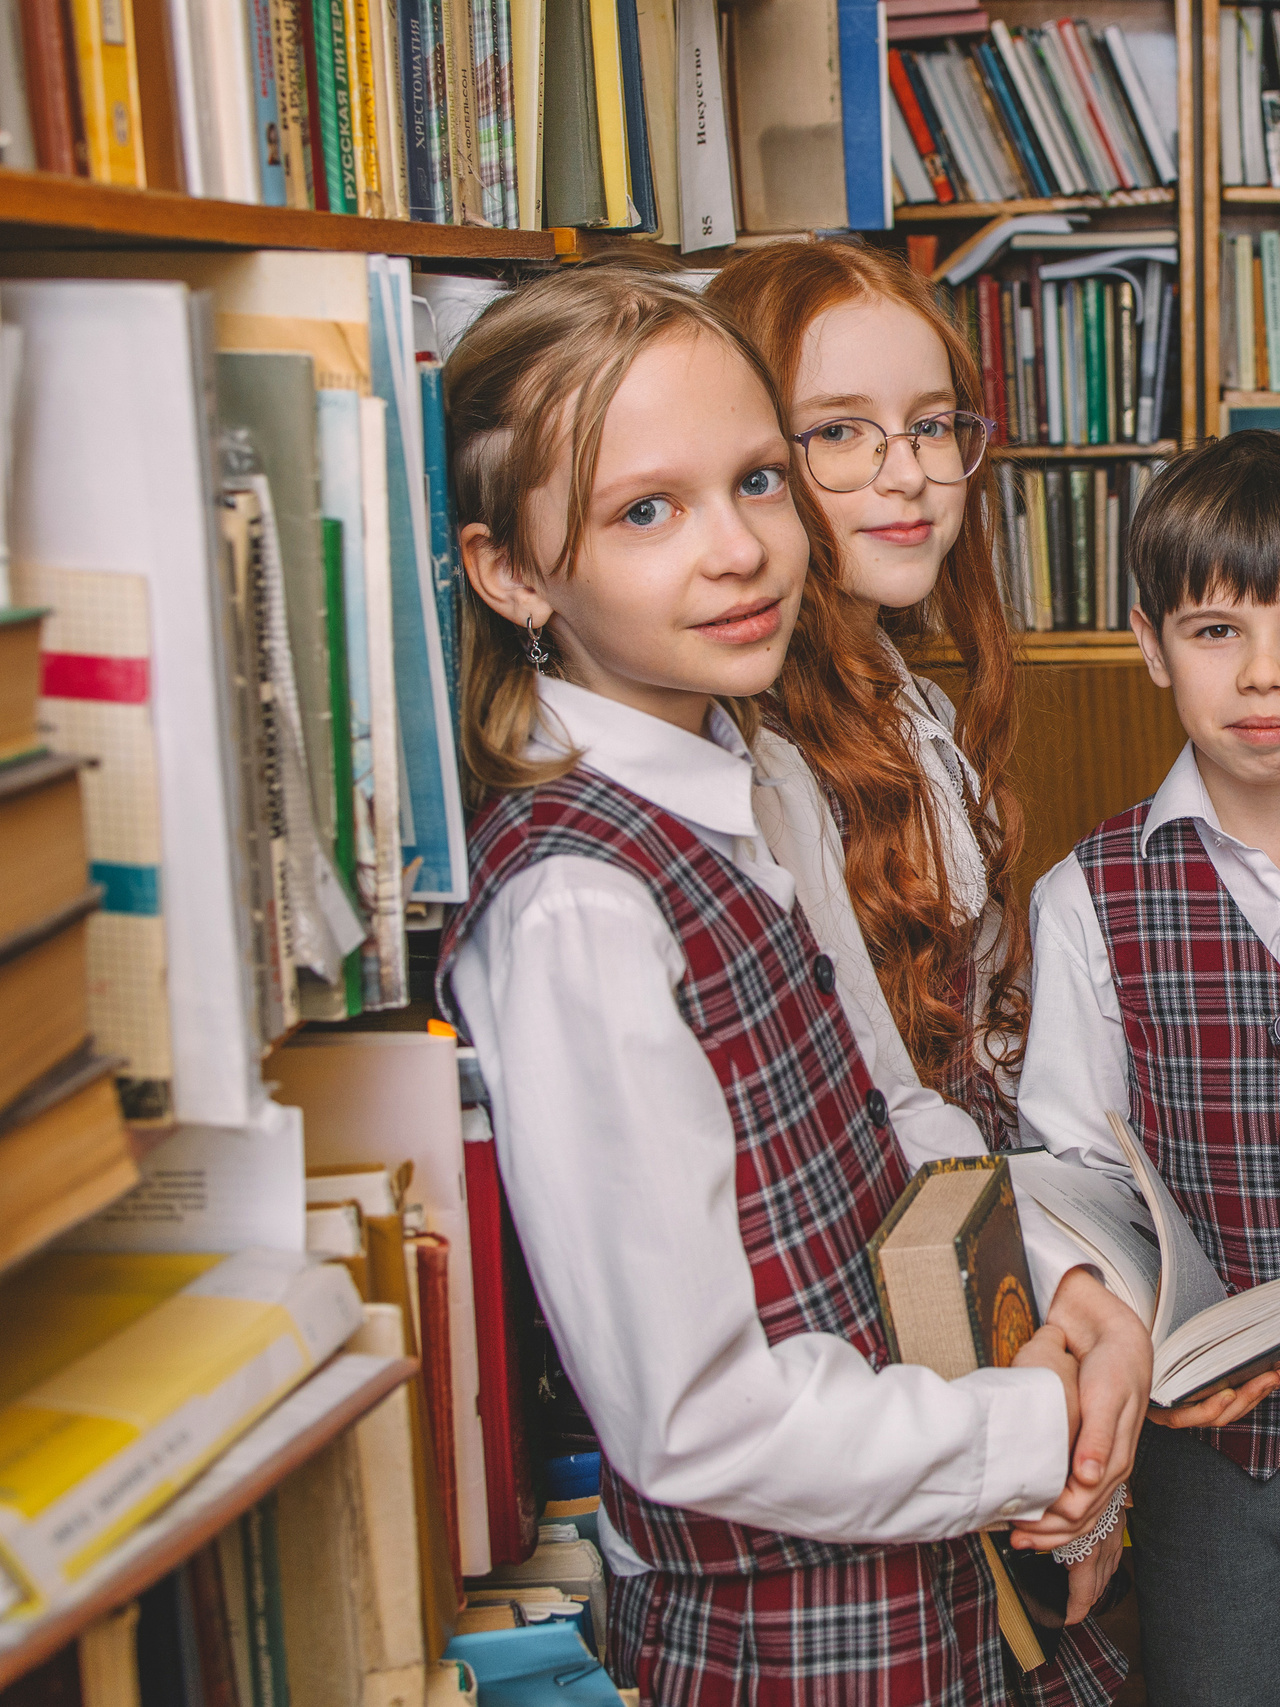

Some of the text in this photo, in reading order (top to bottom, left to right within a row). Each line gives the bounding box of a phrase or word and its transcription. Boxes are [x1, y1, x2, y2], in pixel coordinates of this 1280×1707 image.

[329, 0, 357, 200] РУССКАЯ ЛИТЕР
[409, 18, 426, 149] ХРЕСТОМАТИЯ
[434, 42, 446, 131] КЛАССИКА
[442, 2, 457, 178] ЛИТЕРАТУРНЫЕ НАПРАВЛЕНИЯ
[493, 65, 502, 105] ВСЕХ
[693, 46, 708, 147] Искусство
[440, 137, 451, 214] РУССКАЯ
[495, 113, 505, 181] НАЧАЛО
[701, 215, 714, 236] 85
